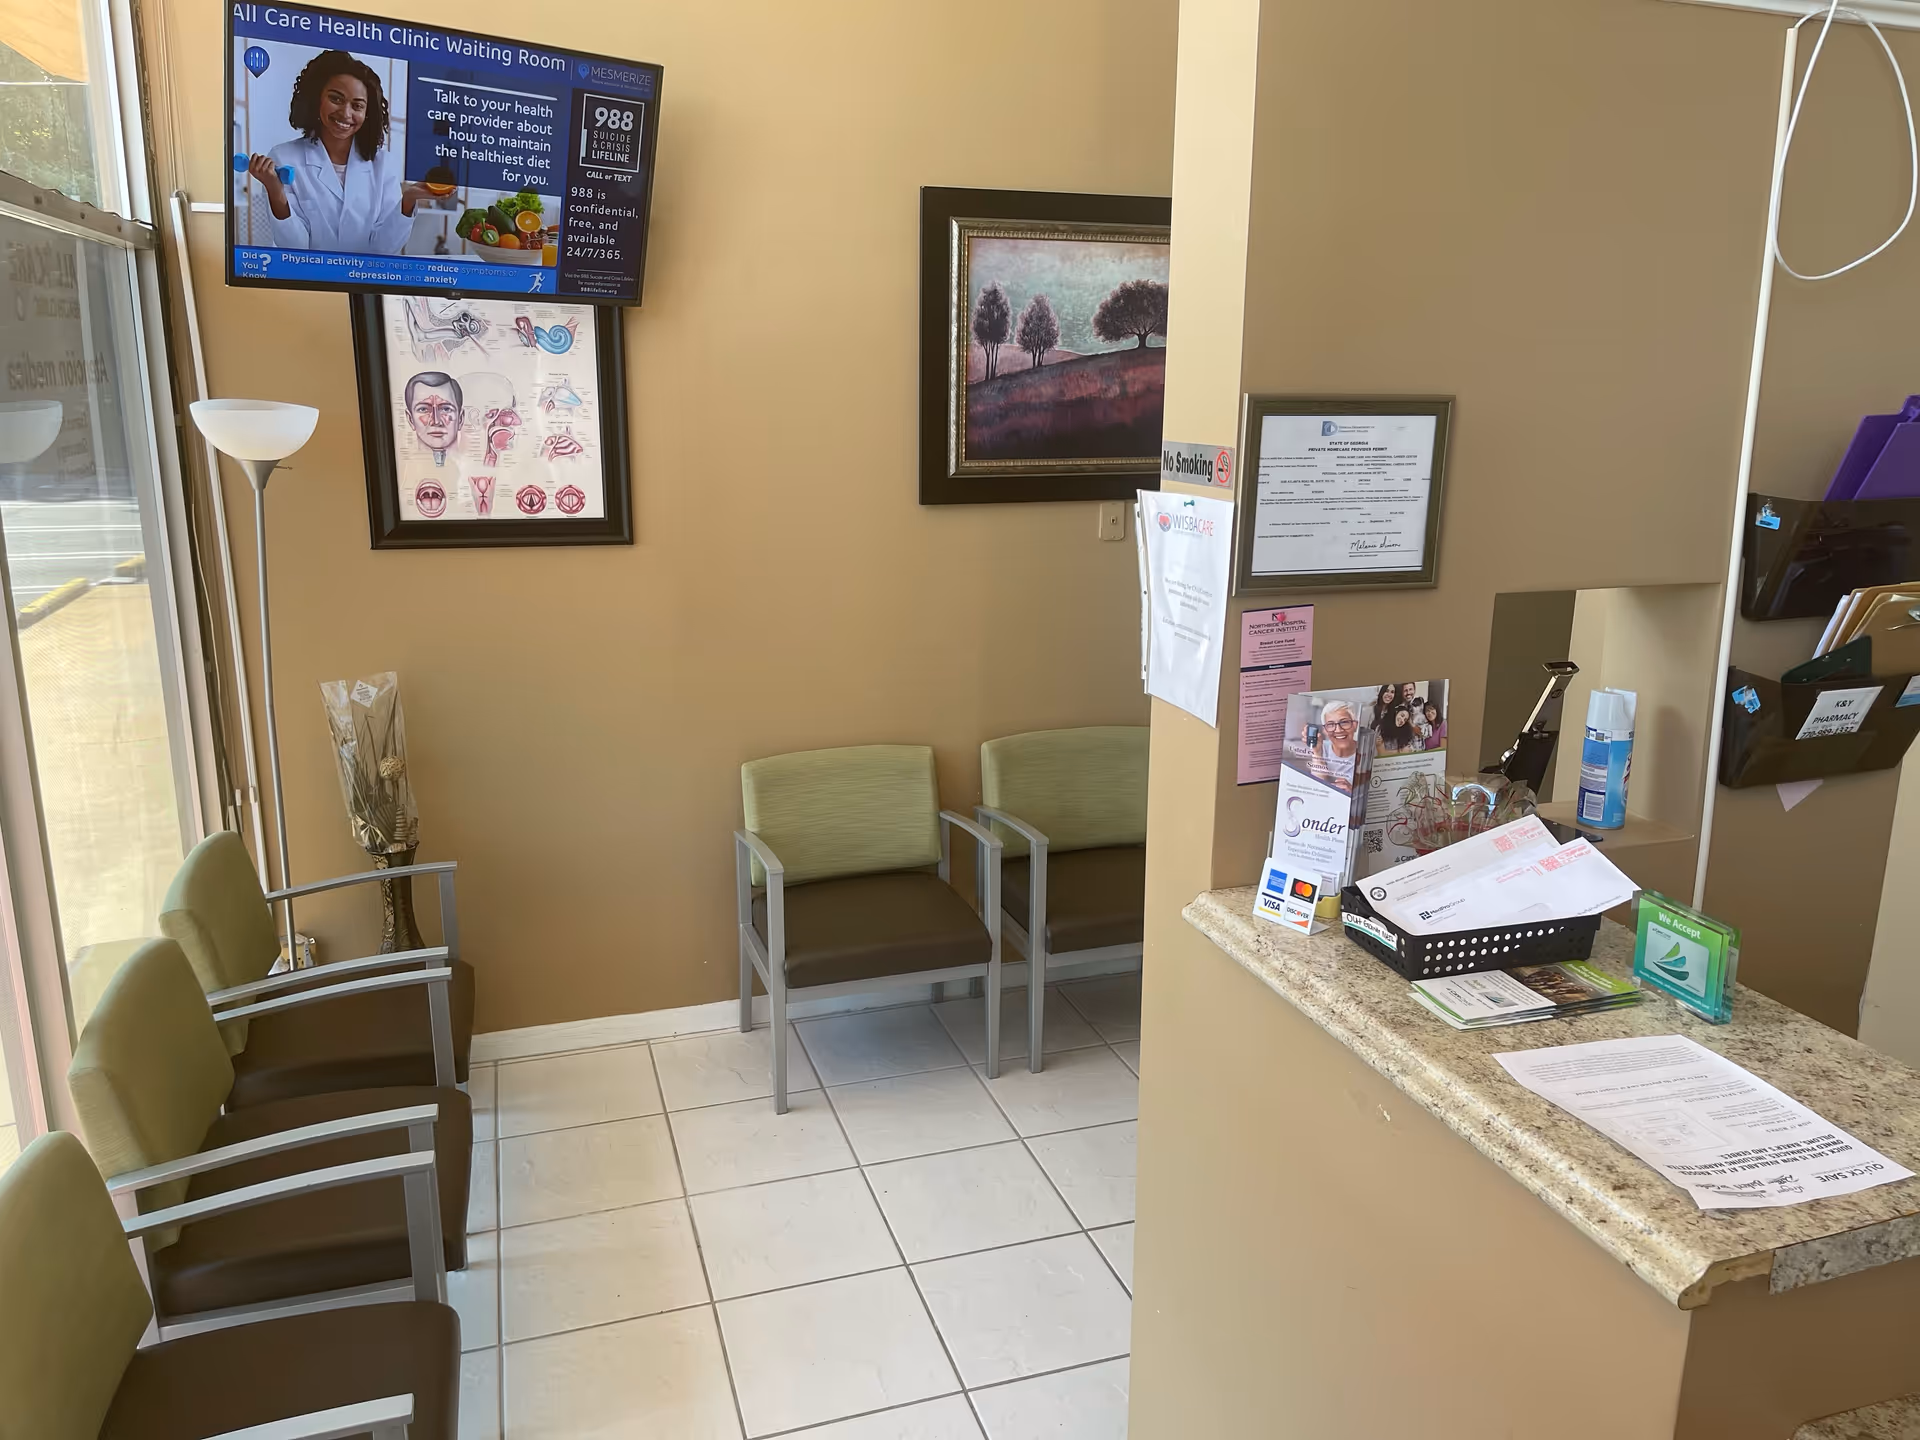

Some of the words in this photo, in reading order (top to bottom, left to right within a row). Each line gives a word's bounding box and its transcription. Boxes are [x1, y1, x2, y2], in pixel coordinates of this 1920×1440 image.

[233, 3, 256, 23] All
[265, 8, 311, 31] Care
[319, 16, 382, 42] Health
[389, 27, 440, 50] Clinic
[446, 36, 512, 66] Waiting
[518, 49, 565, 72] Room
[591, 66, 652, 87] MESMERIZE
[434, 88, 460, 105] Talk
[463, 95, 478, 107] to
[481, 99, 511, 112] your
[514, 101, 553, 118] health
[427, 109, 456, 122] care
[460, 114, 513, 130] provider
[516, 120, 553, 135] about
[594, 106, 634, 132] 988
[448, 127, 477, 142] how
[481, 133, 495, 145] to
[499, 136, 551, 152] maintain
[593, 130, 631, 144] SUICIDE
[592, 140, 598, 149] &
[600, 141, 630, 153] CRISIS
[435, 144, 458, 158] the
[461, 146, 524, 166] healthiest
[527, 155, 551, 169] diet
[592, 150, 630, 163] LIFELINE
[502, 168, 521, 182] for
[523, 174, 549, 186] you.
[586, 171, 603, 180] CALL
[614, 174, 632, 183] TEXT
[571, 186, 593, 199] 988
[597, 189, 606, 200] is
[569, 203, 639, 219] confidential,
[568, 216, 595, 229] free,
[598, 221, 618, 231] and
[567, 233, 615, 245] available
[566, 246, 624, 260] 24/7/365.
[242, 262, 258, 270] You
[281, 253, 324, 265] Physical
[327, 256, 364, 268] activity
[427, 263, 459, 274] reduce
[348, 270, 401, 282] depression
[424, 275, 458, 286] anxiety
[1162, 450, 1174, 472] No
[1176, 451, 1214, 483] Smoking
[1172, 513, 1215, 537] WISBACARE
[1275, 625, 1307, 633] INSTITUTE
[1834, 699, 1855, 708] K&Y
[1812, 711, 1860, 725] PHARMACY
[1283, 796, 1346, 837] Sonder
[1263, 898, 1280, 911] VISA
[1286, 907, 1309, 919] DISCOVER
[1658, 911, 1671, 925] We
[1672, 919, 1701, 940] Accept
[1751, 1147, 1768, 1155] AND
[1816, 1139, 1844, 1150] OWNED
[1830, 1144, 1853, 1155] QUICK
[1724, 1155, 1766, 1166] INCLUDING
[1780, 1156, 1799, 1165] NOW
[1807, 1151, 1829, 1159] SAVE
[1695, 1162, 1725, 1171] HARRIS
[1739, 1160, 1780, 1171] AVAILABLE
[1847, 1163, 1884, 1177] QUICK
[1815, 1172, 1848, 1183] SAVE
